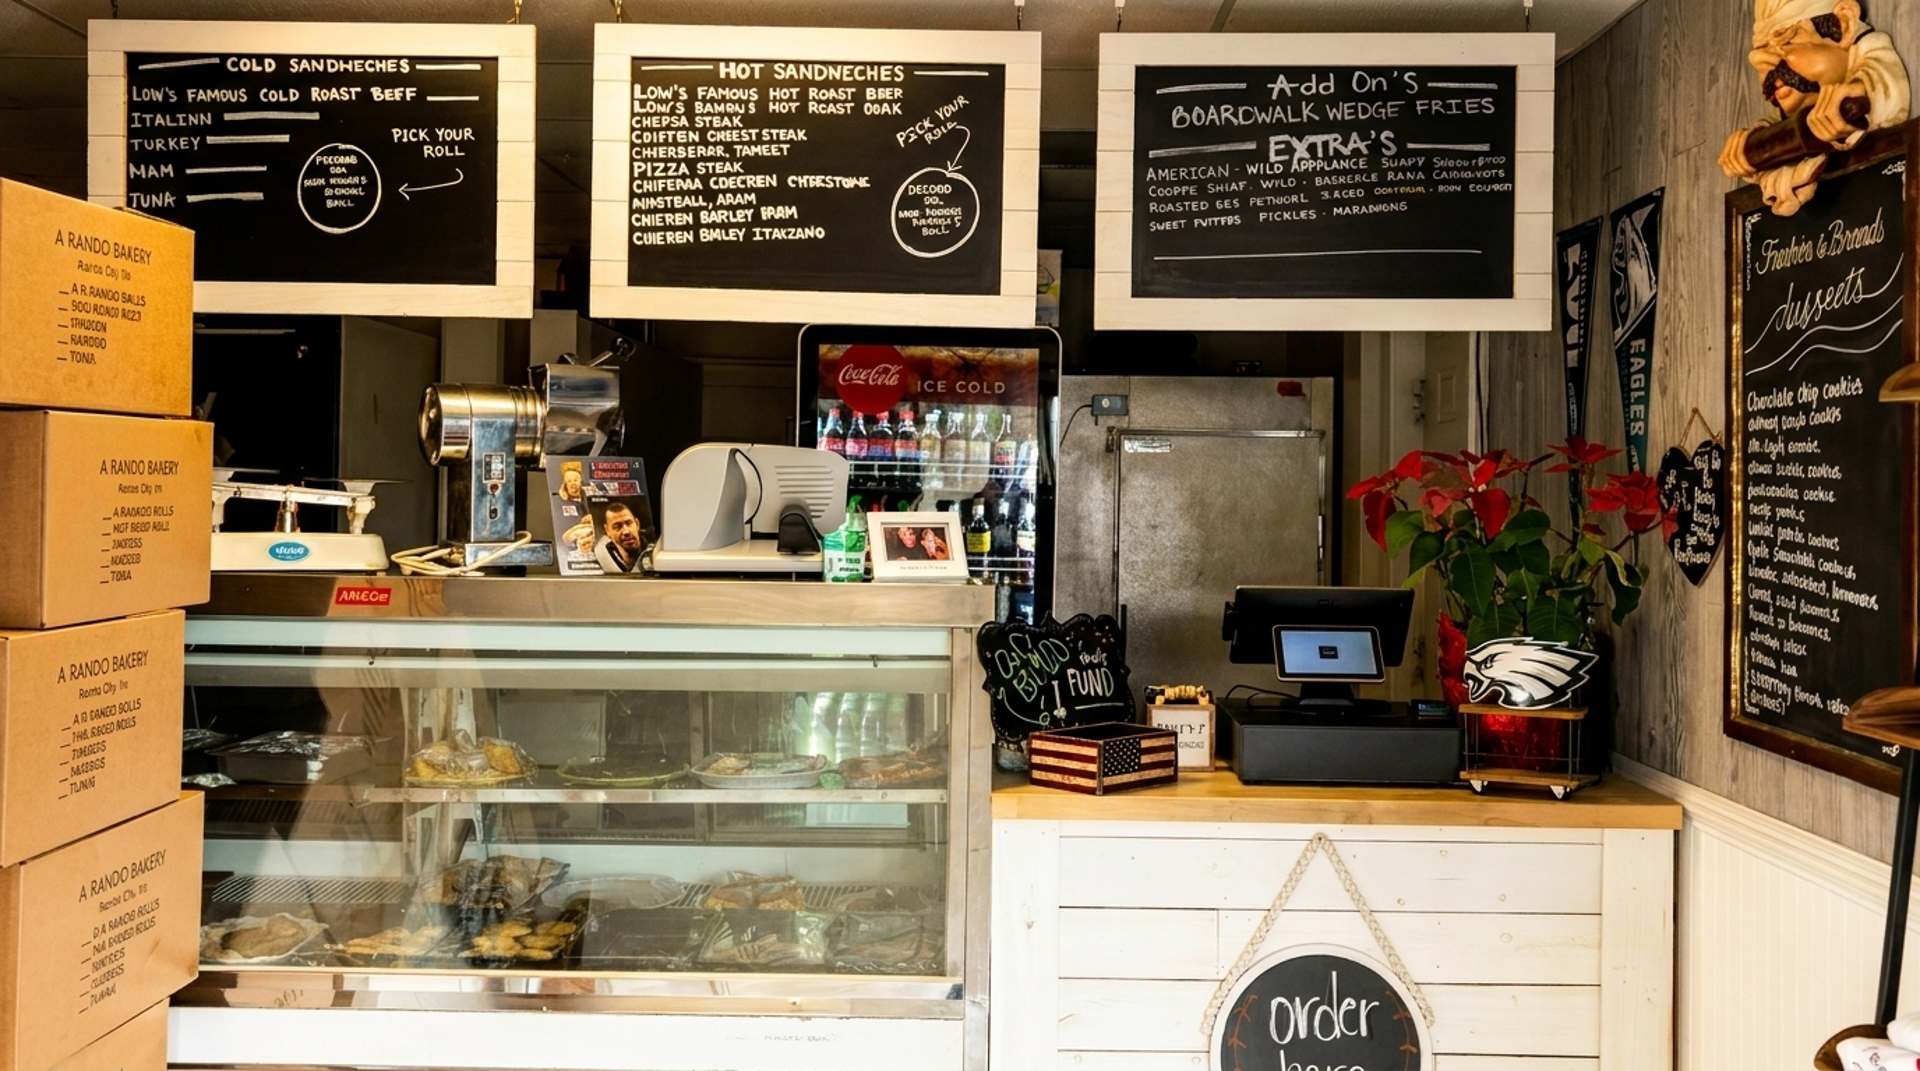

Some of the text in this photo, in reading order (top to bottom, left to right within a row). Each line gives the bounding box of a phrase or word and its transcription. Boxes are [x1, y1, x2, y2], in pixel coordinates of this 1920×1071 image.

[226, 57, 276, 72] COLD
[719, 62, 764, 79] HOT
[187, 88, 247, 102] FAMOUS
[260, 88, 300, 102] COLD
[311, 87, 361, 102] ROAST
[370, 87, 417, 101] BEFF
[633, 84, 688, 100] LOW'S
[697, 86, 758, 100] FAMOUS
[769, 87, 800, 100] HOT
[808, 87, 856, 100] ROAST
[1267, 73, 1335, 100] Add
[769, 101, 800, 114] HOT
[1171, 97, 1495, 128] BOARDWALK WEDGE FRIES
[631, 115, 743, 128] CHEPSA STEAK
[391, 128, 475, 142] PICK YOUR
[130, 137, 200, 151] TURKEY
[424, 145, 465, 158] ROLL
[1269, 130, 1397, 163] EXTRA'S
[129, 163, 174, 179] MAM
[633, 162, 744, 178] PIZZA STEAK
[1146, 164, 1229, 181] AMERICAN
[1246, 163, 1283, 175] WILD
[1387, 171, 1425, 181] RANA
[129, 192, 176, 208] TUNA
[1149, 201, 1209, 213] ROASTED
[1149, 220, 1187, 232] SWEET
[1259, 210, 1317, 222] PICKLES
[54, 229, 64, 246] A
[68, 231, 111, 256] RANDO
[917, 380, 1006, 394] ICE COLD
[100, 459, 108, 475] A
[57, 649, 149, 684] A RANDO BAKERY
[1066, 667, 1114, 698] FUND
[78, 884, 87, 903] A
[90, 866, 129, 898] RANDO
[130, 849, 167, 879] BAKERY
[1269, 971, 1380, 1045] order
